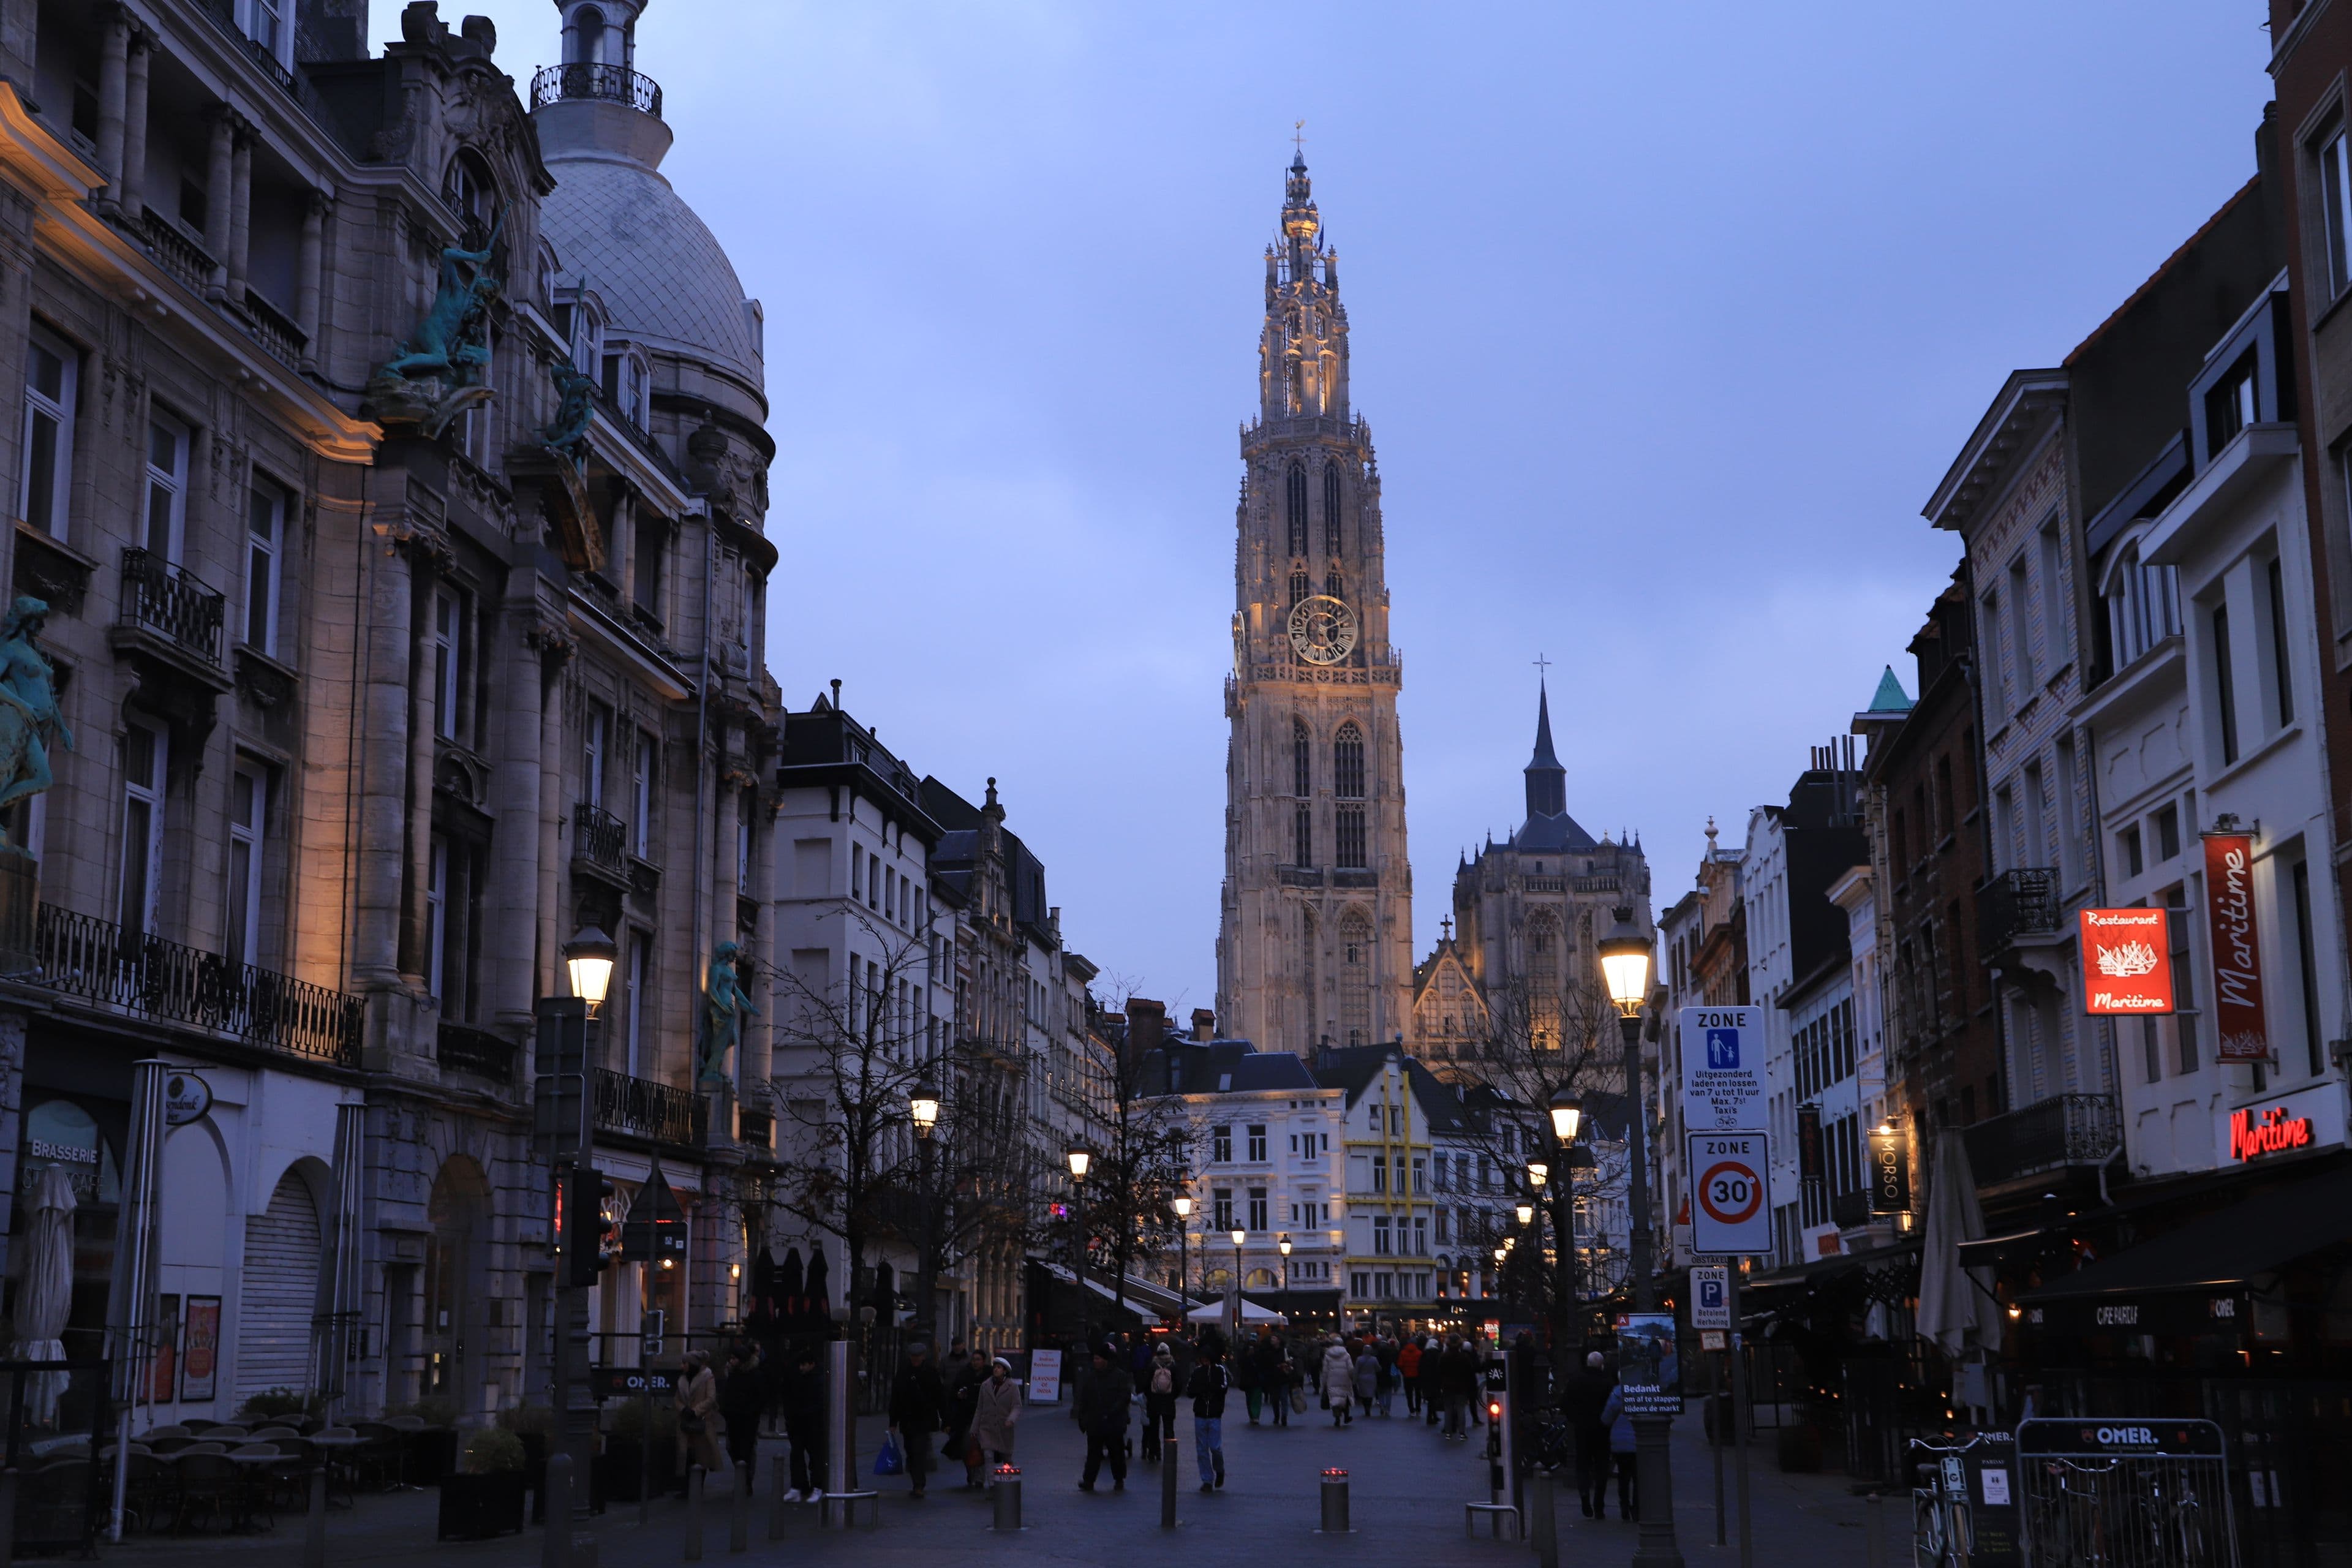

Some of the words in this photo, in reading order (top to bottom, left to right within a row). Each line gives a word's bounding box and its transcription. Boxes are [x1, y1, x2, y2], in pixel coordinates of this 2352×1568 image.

[2086, 911, 2158, 927] Restaurant
[2217, 848, 2257, 1007] Maritime
[2094, 992, 2165, 1009] Maritime
[1698, 1013, 1746, 1027] ZONE
[1695, 1070, 1752, 1080] Uitgezonderd
[2230, 1107, 2309, 1163] Maritime
[1706, 1142, 1750, 1155] ZONE
[1880, 1138, 1898, 1198] MORSO
[1714, 1180, 1747, 1203] 30
[1697, 1271, 1725, 1280] ZONE
[1705, 1283, 1717, 1300] P
[1697, 1318, 1728, 1327] Herhaling
[1623, 1384, 1660, 1393] Bedankt
[2097, 1427, 2160, 1444] OMER.
